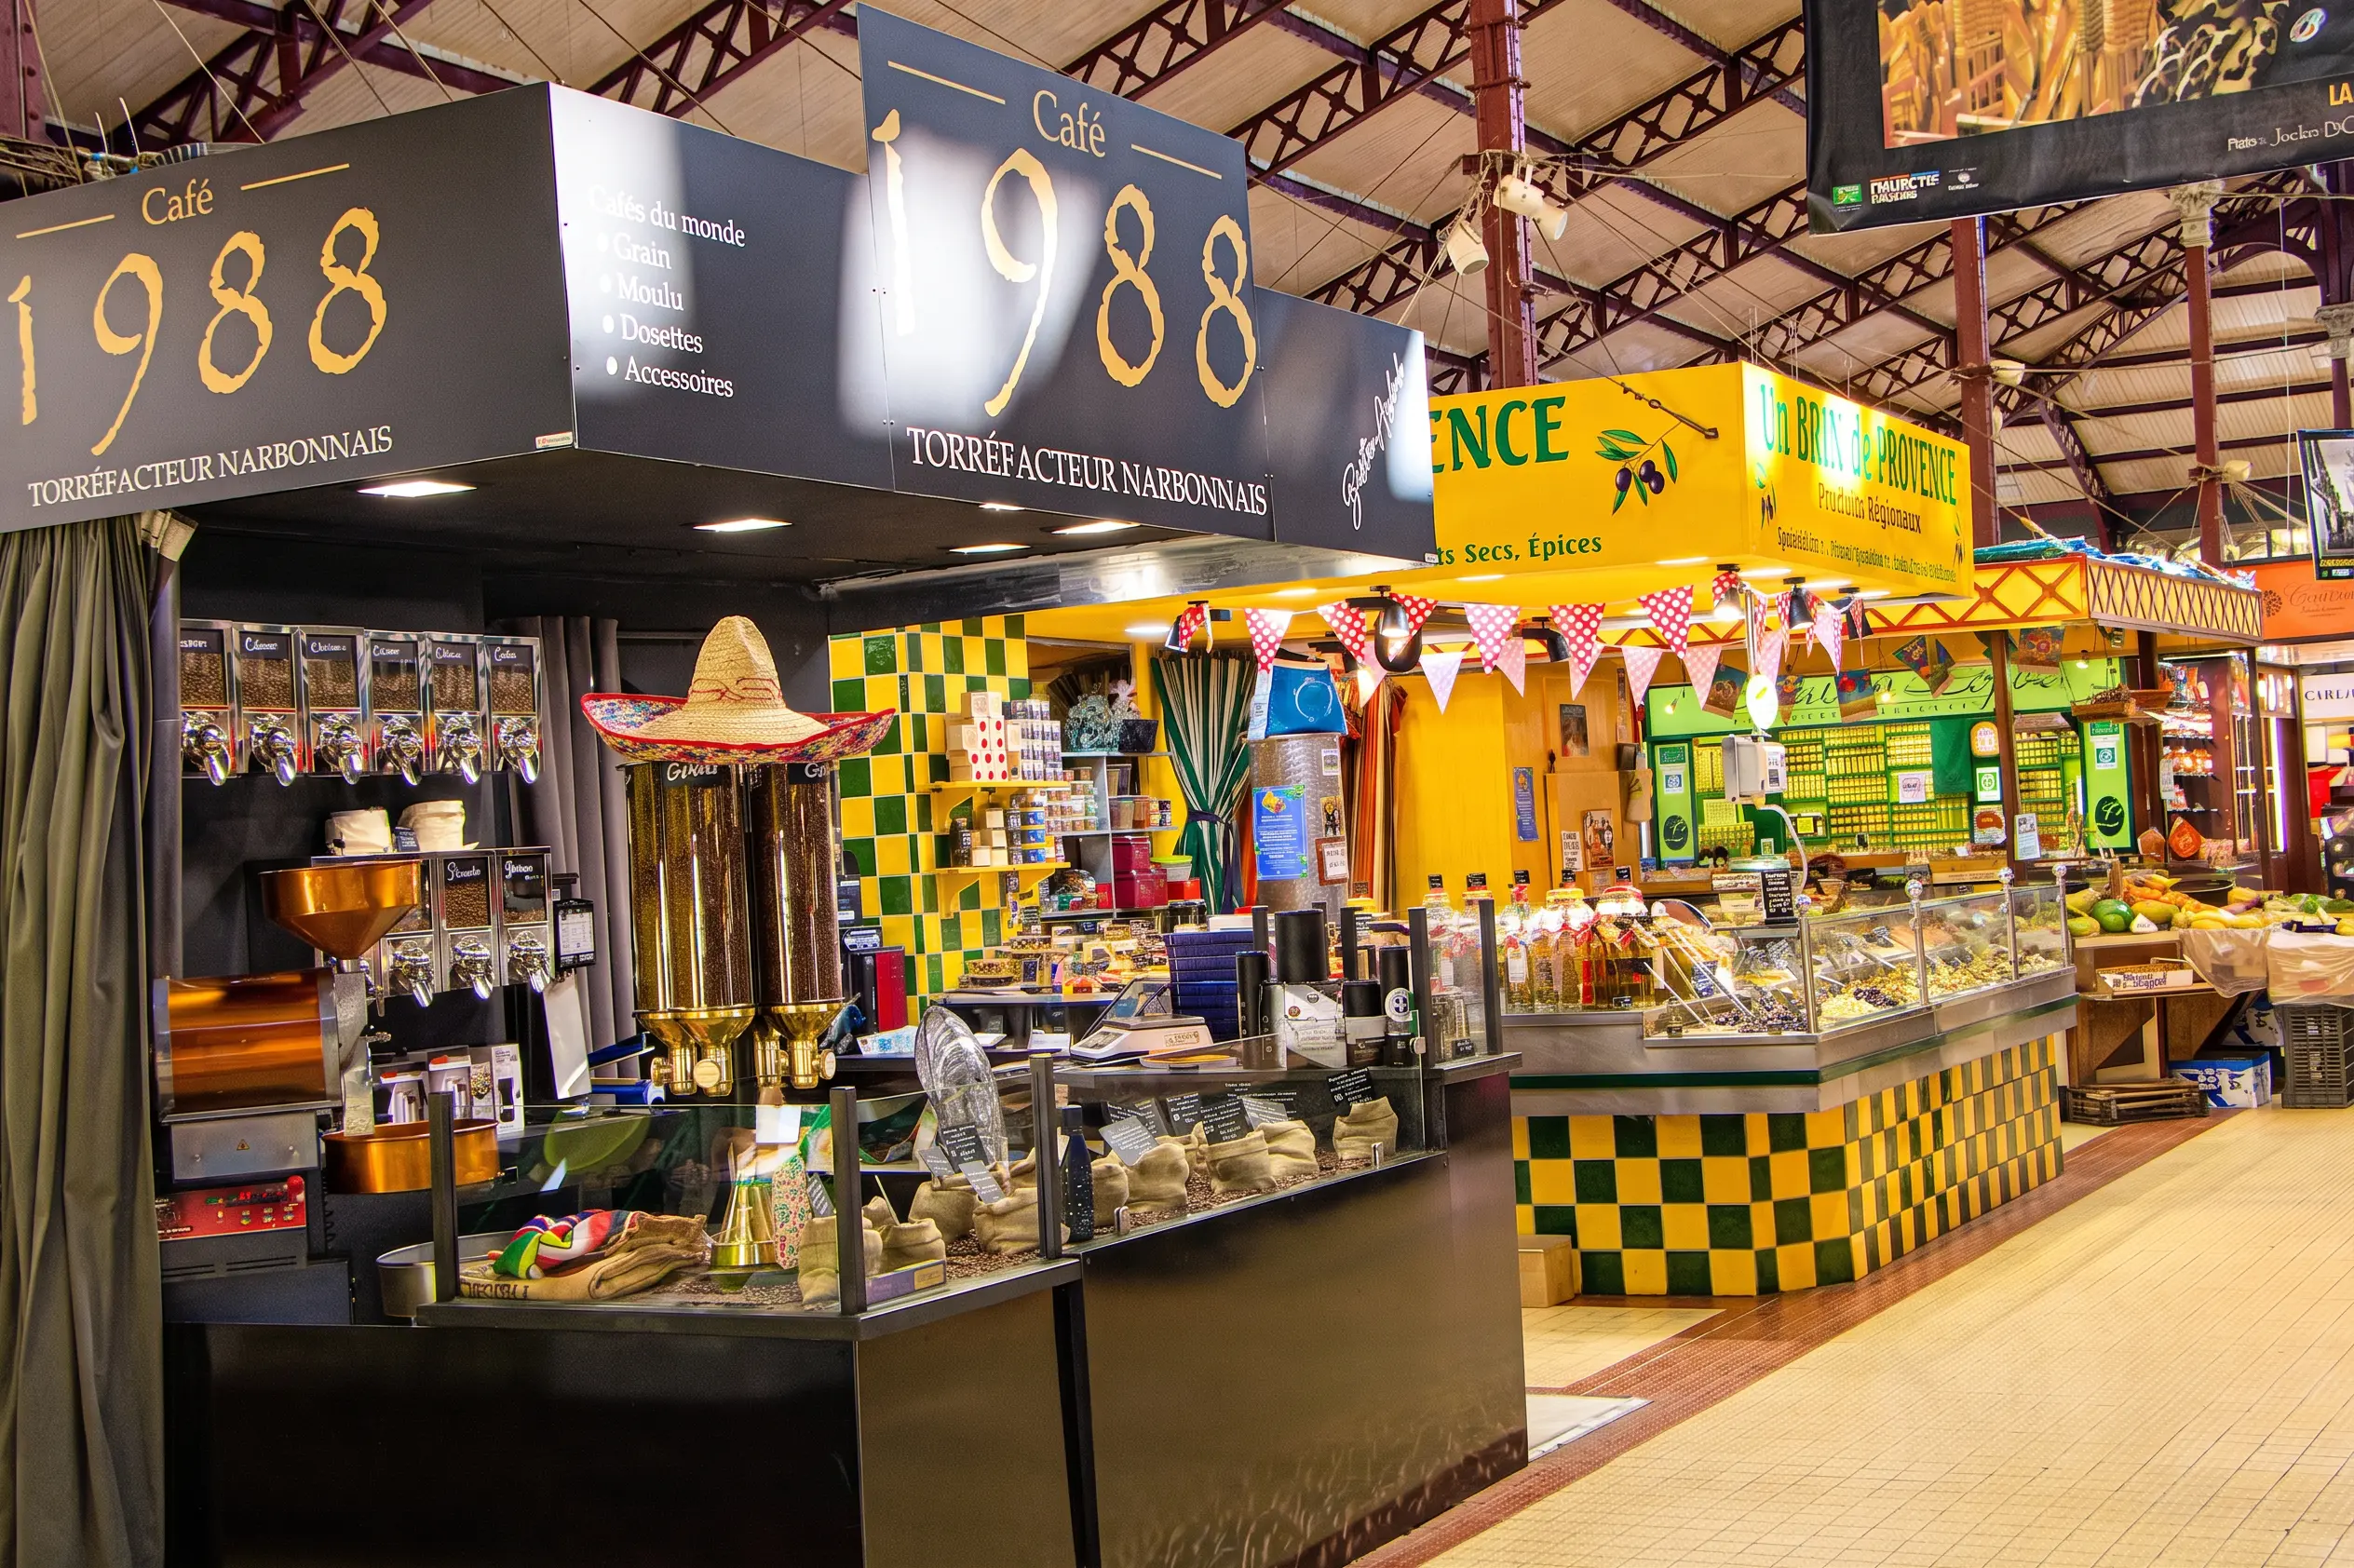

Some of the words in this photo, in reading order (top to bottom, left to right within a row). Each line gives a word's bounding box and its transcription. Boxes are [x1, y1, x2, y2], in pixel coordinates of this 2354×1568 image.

[1033, 89, 1106, 158] Café
[142, 179, 213, 225] Café
[589, 186, 646, 223] Cafés
[651, 201, 677, 231] du
[681, 215, 746, 248] monde
[614, 232, 672, 270] Grain
[872, 108, 1257, 417] 1988
[616, 273, 684, 311] Moulu
[7, 206, 387, 456] 1988
[619, 314, 703, 354] Dosettes
[625, 356, 734, 398] Accessoires
[28, 455, 215, 508] TORRÉFACTEUR
[217, 425, 394, 478] NARBONNAIS
[906, 426, 1118, 493] TORRÉFACTEUR
[1120, 460, 1267, 516] NARBONNAIS
[1760, 384, 1791, 455] Un
[1796, 396, 1844, 472] BRIN
[1850, 412, 1873, 481] de
[1876, 425, 1957, 507] PROVENCE
[1867, 495, 1922, 534] Régionaux
[1465, 544, 1521, 563] Secs,
[1527, 532, 1602, 561] Épices
